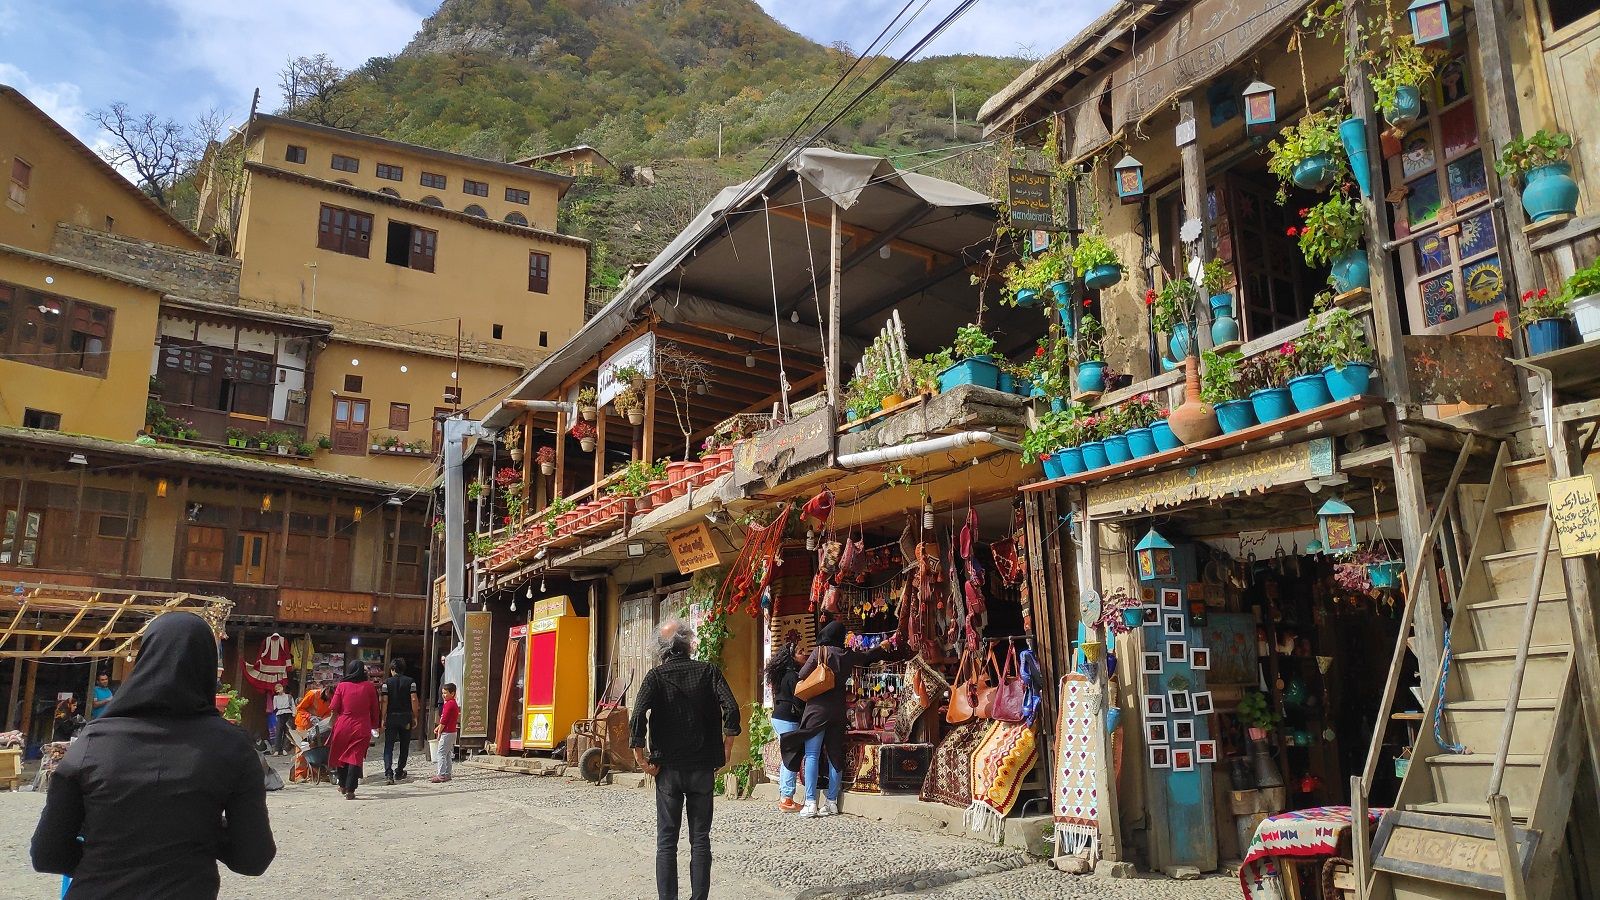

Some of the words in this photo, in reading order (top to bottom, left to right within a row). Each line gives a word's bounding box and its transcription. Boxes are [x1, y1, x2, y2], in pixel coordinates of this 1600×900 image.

[1011, 196, 1029, 206] دستی
[1030, 198, 1049, 209] صنایع
[1245, 451, 1296, 477] نمایشگاه
[1161, 473, 1190, 495] صنایع
[1555, 491, 1571, 511] عکس
[1568, 492, 1577, 510] از
[1564, 511, 1576, 521] روی
[1577, 502, 1597, 517] گرفتن
[1577, 515, 1592, 529] بالکن
[285, 598, 302, 611] باران
[303, 599, 322, 612] محلی
[323, 601, 338, 613] لباس
[346, 602, 368, 614] عکاسی
